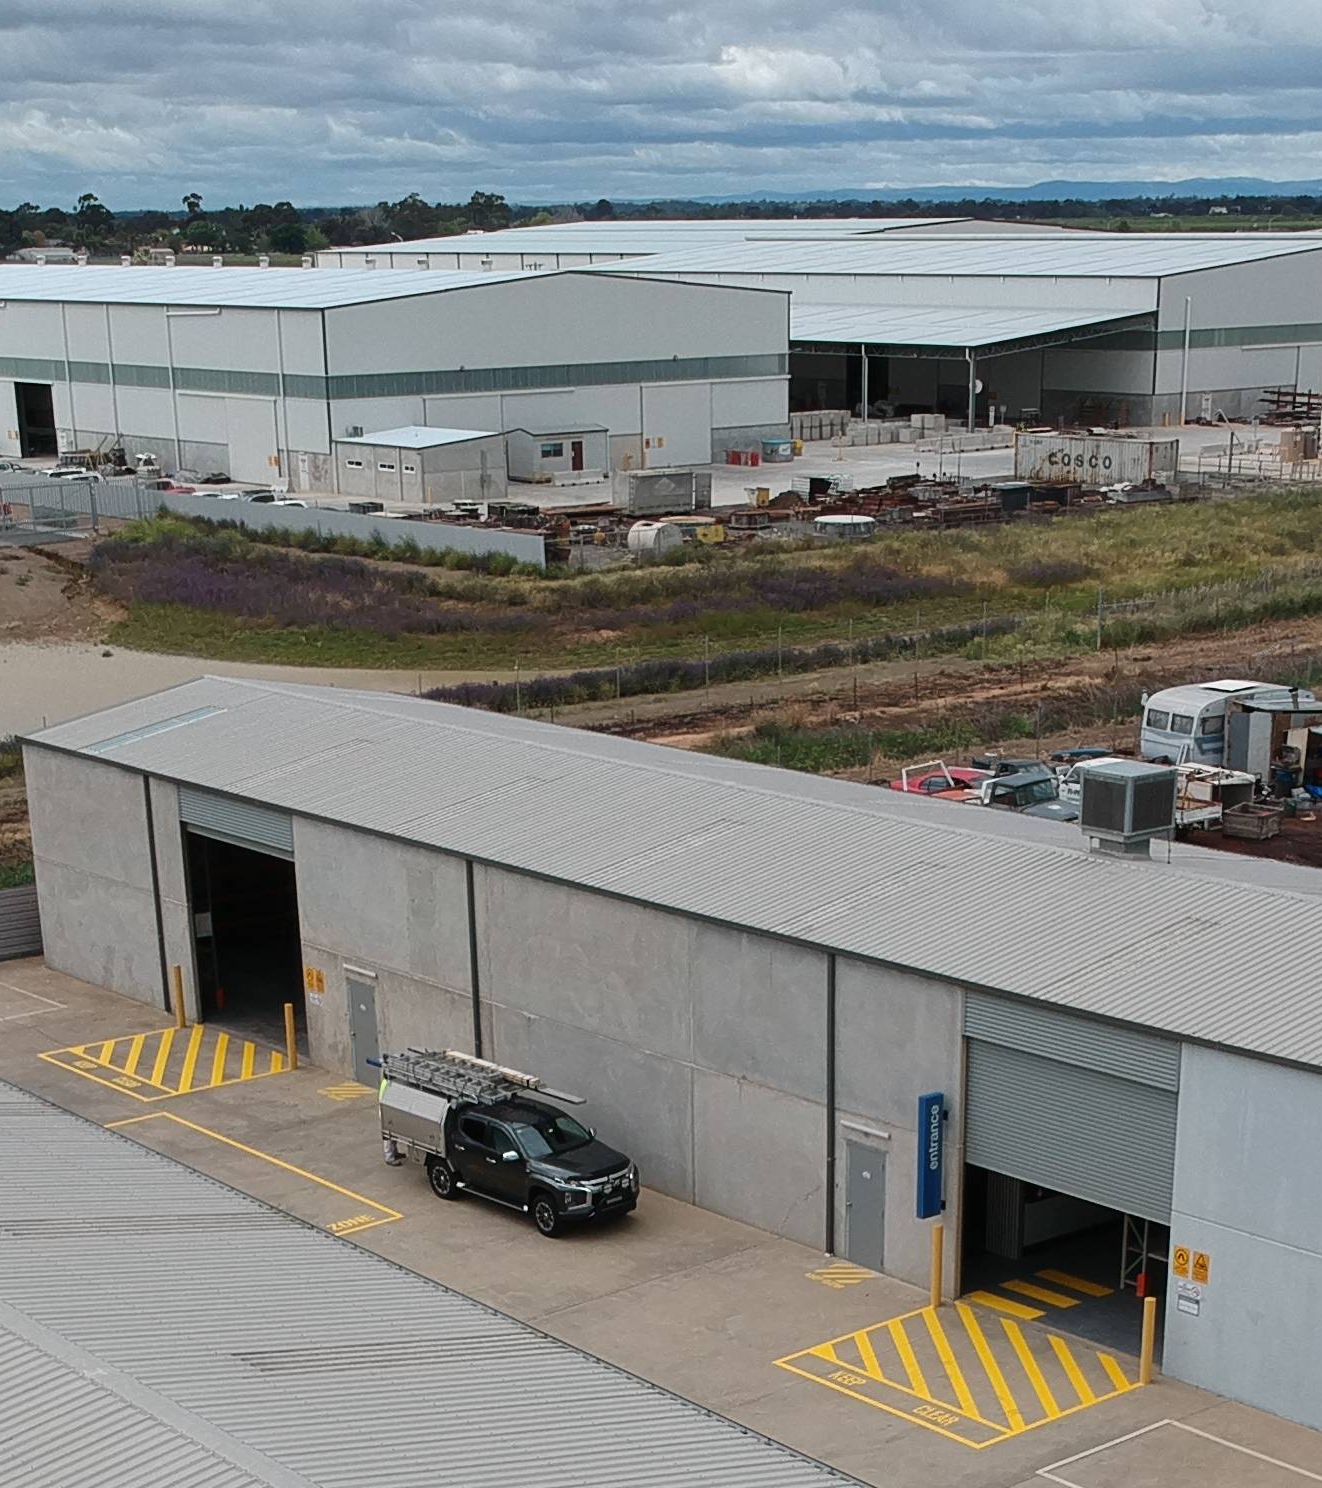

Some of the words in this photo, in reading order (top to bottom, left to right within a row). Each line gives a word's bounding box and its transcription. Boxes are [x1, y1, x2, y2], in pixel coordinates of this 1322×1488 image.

[1048, 450, 1113, 470] COSCO
[929, 1104, 940, 1170] entrance
[828, 1370, 867, 1386] KEEP
[912, 1404, 960, 1426] CLEAR
